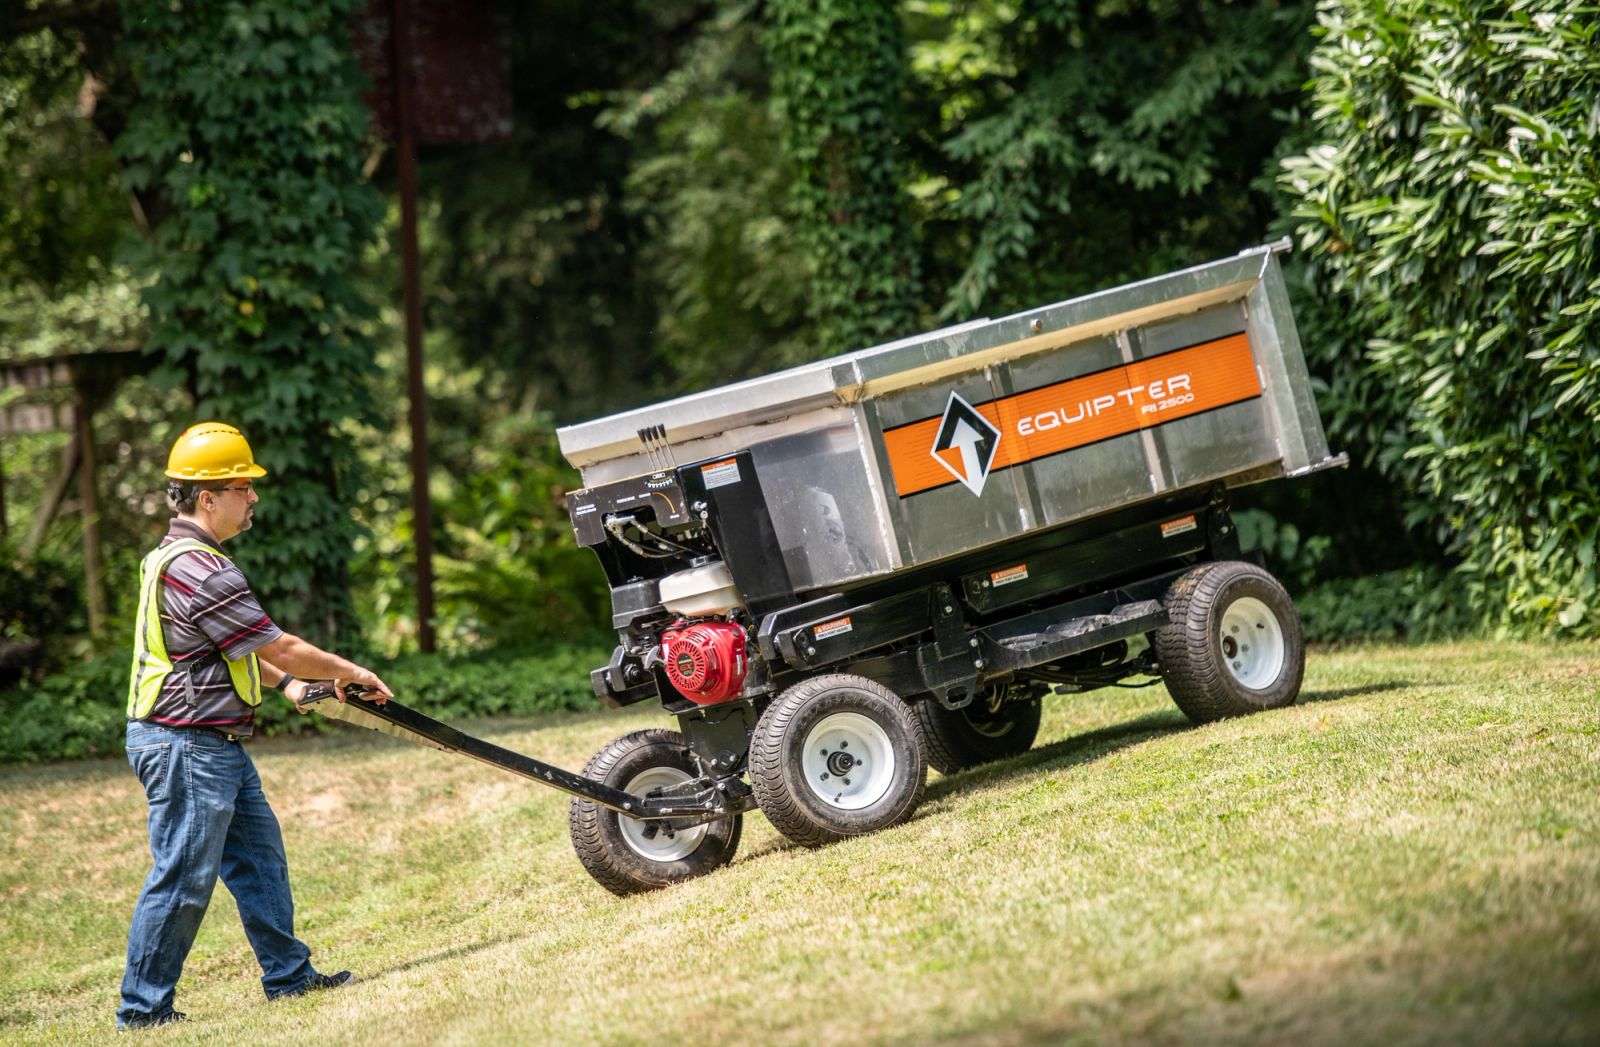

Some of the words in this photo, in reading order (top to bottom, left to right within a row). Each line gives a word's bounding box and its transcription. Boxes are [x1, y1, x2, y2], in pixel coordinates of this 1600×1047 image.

[1017, 373, 1191, 436] EQUIPTER
[1159, 392, 1194, 411] 2500
[821, 618, 848, 631] WARNING
